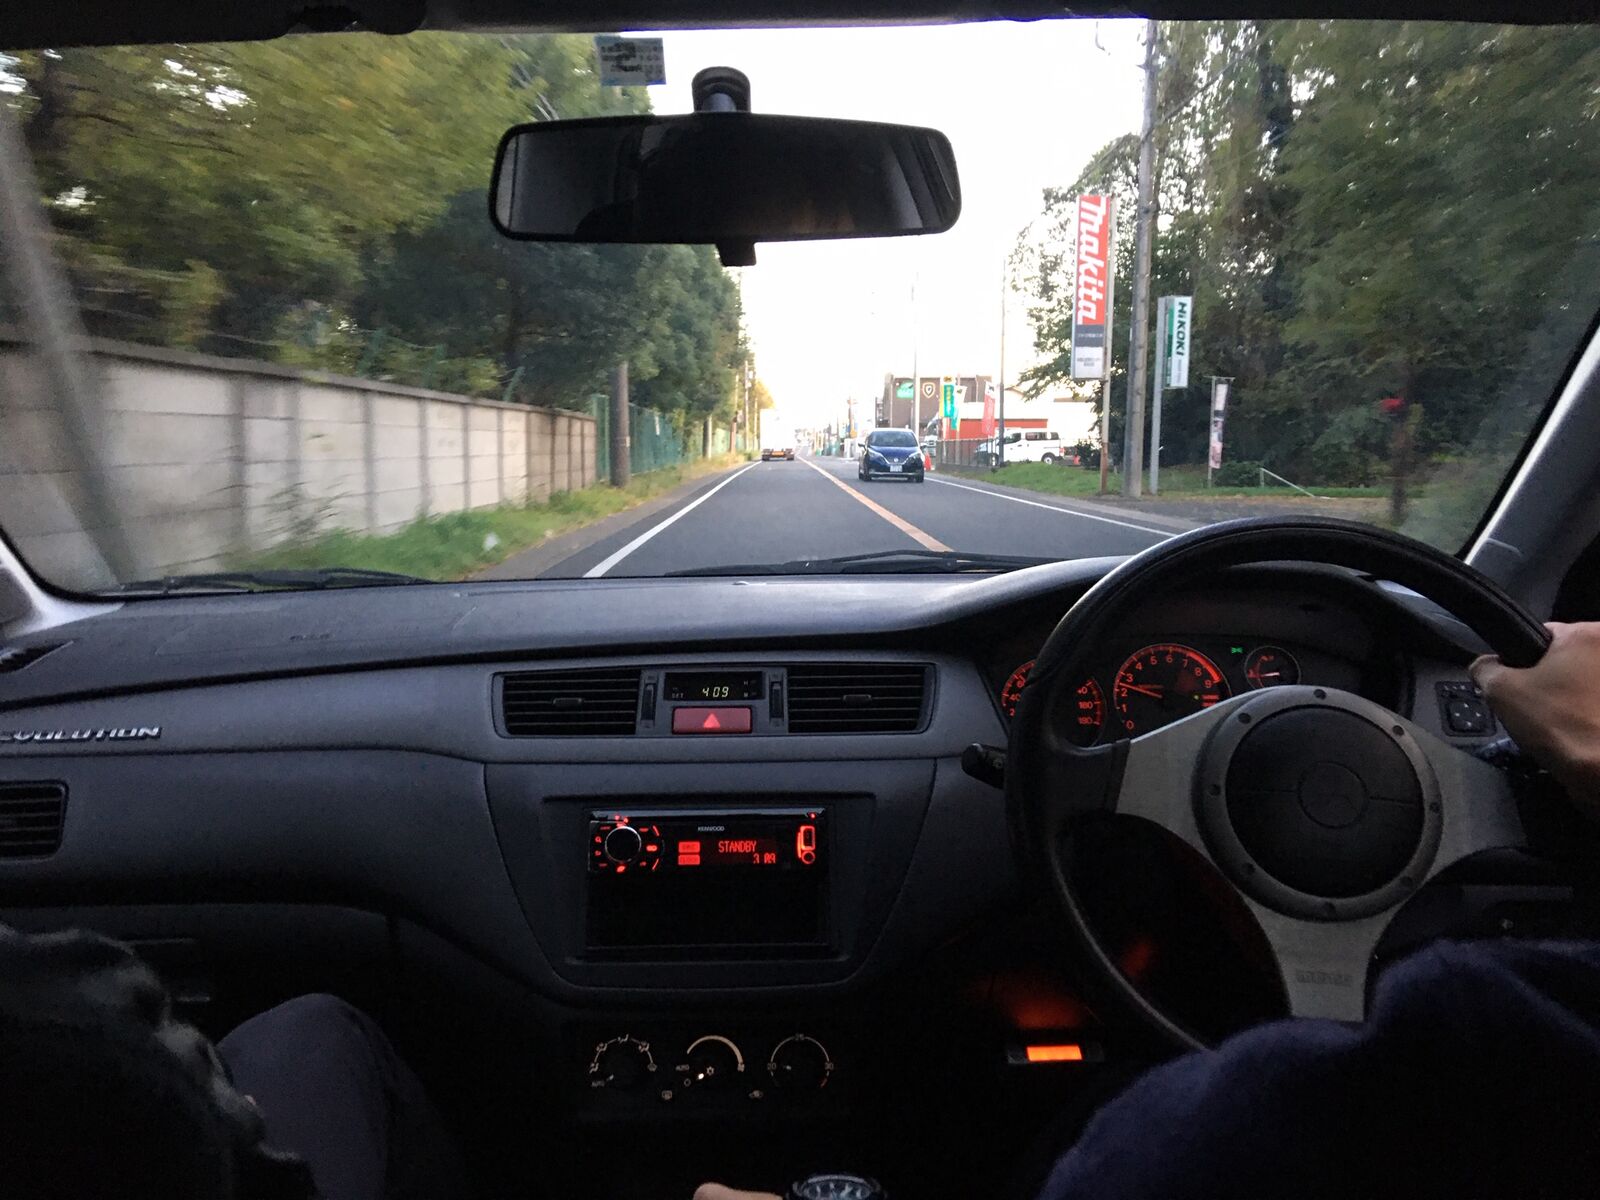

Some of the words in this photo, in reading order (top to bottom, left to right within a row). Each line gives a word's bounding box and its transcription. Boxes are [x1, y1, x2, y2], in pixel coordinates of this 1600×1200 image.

[1150, 656, 1157, 665] 5
[1166, 655, 1173, 663] 6
[1136, 662, 1142, 670] 4
[1195, 667, 1202, 676] 8
[1126, 674, 1133, 682] 3
[1121, 689, 1128, 697] 2
[1126, 720, 1134, 730] 0
[718, 841, 757, 853] STANDBY
